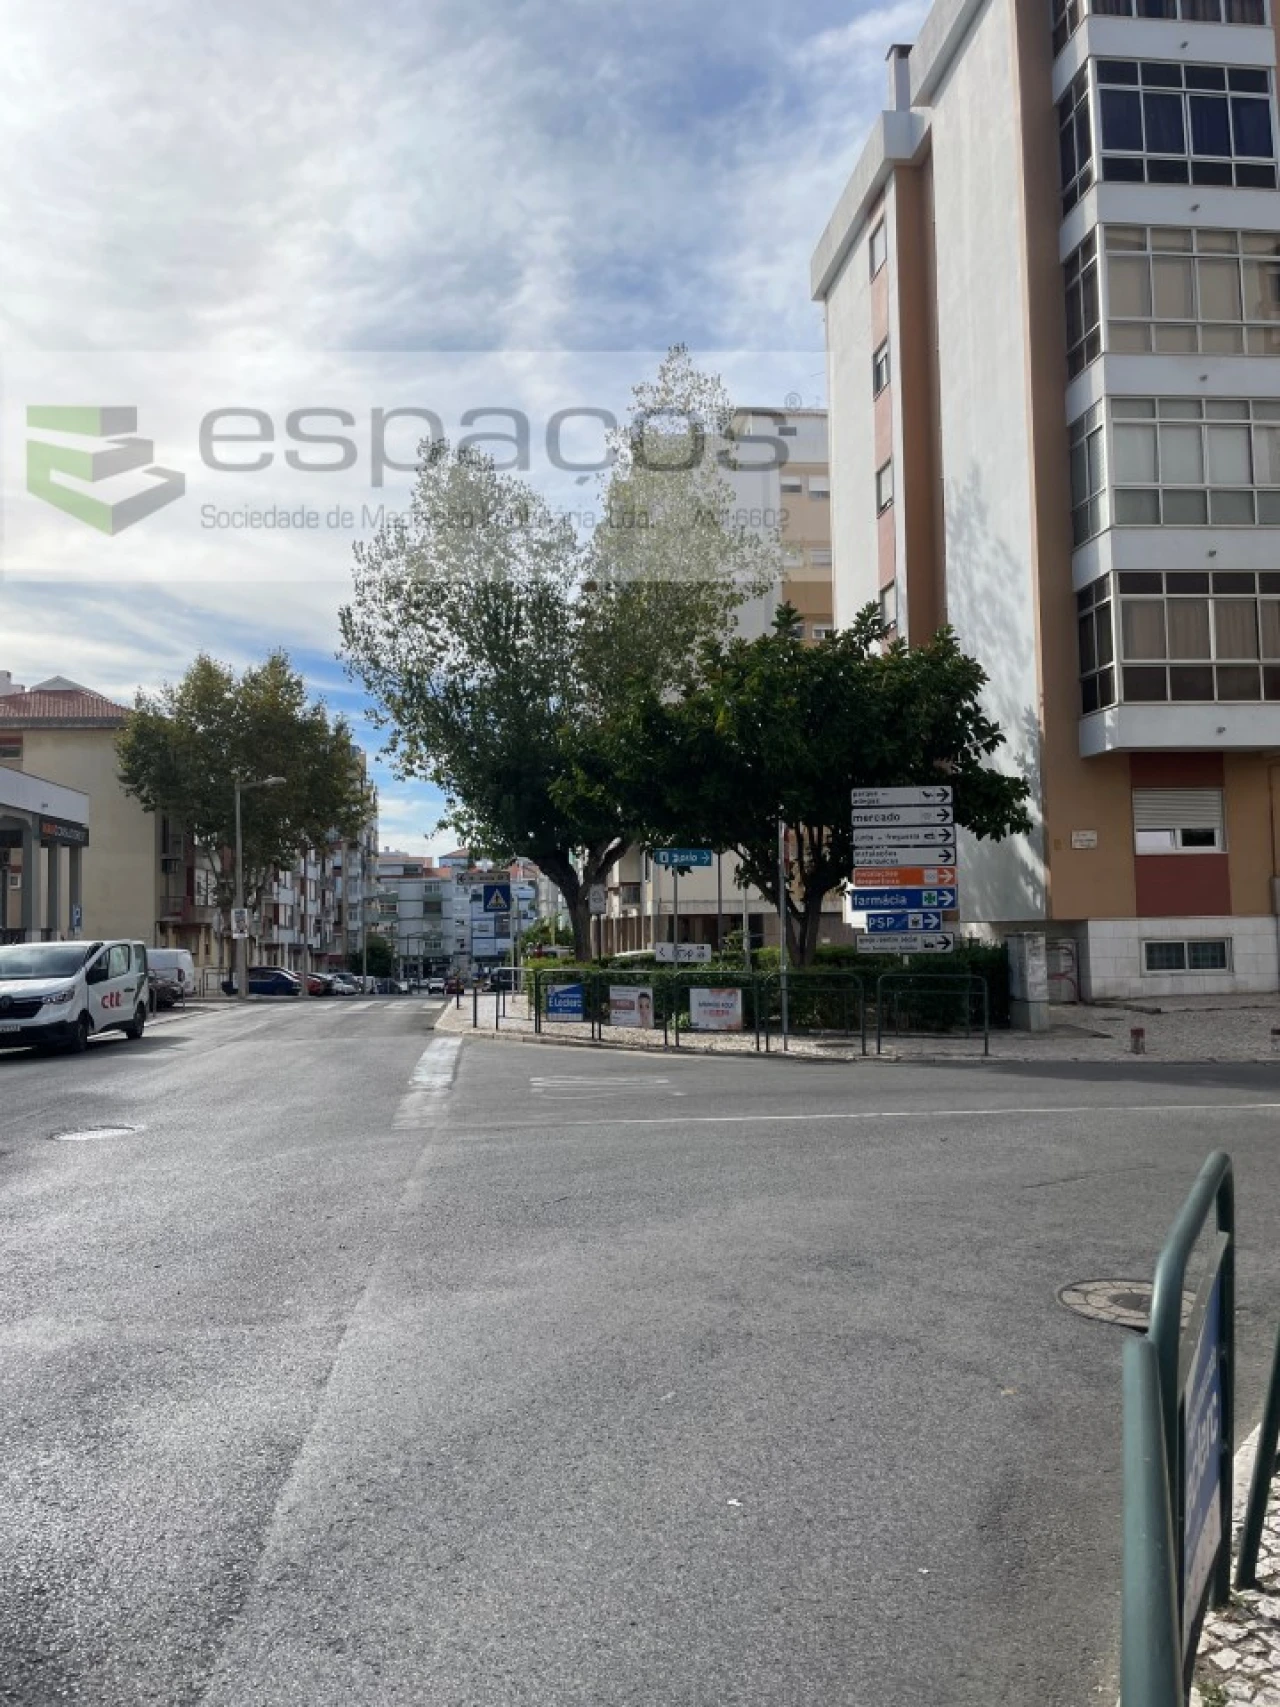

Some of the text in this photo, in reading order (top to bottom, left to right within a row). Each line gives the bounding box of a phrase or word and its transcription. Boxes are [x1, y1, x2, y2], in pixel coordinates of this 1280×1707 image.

[853, 813, 901, 824] mercado
[854, 893, 908, 906] farmácia
[868, 917, 895, 929] PSP
[102, 991, 122, 1009] ctt
